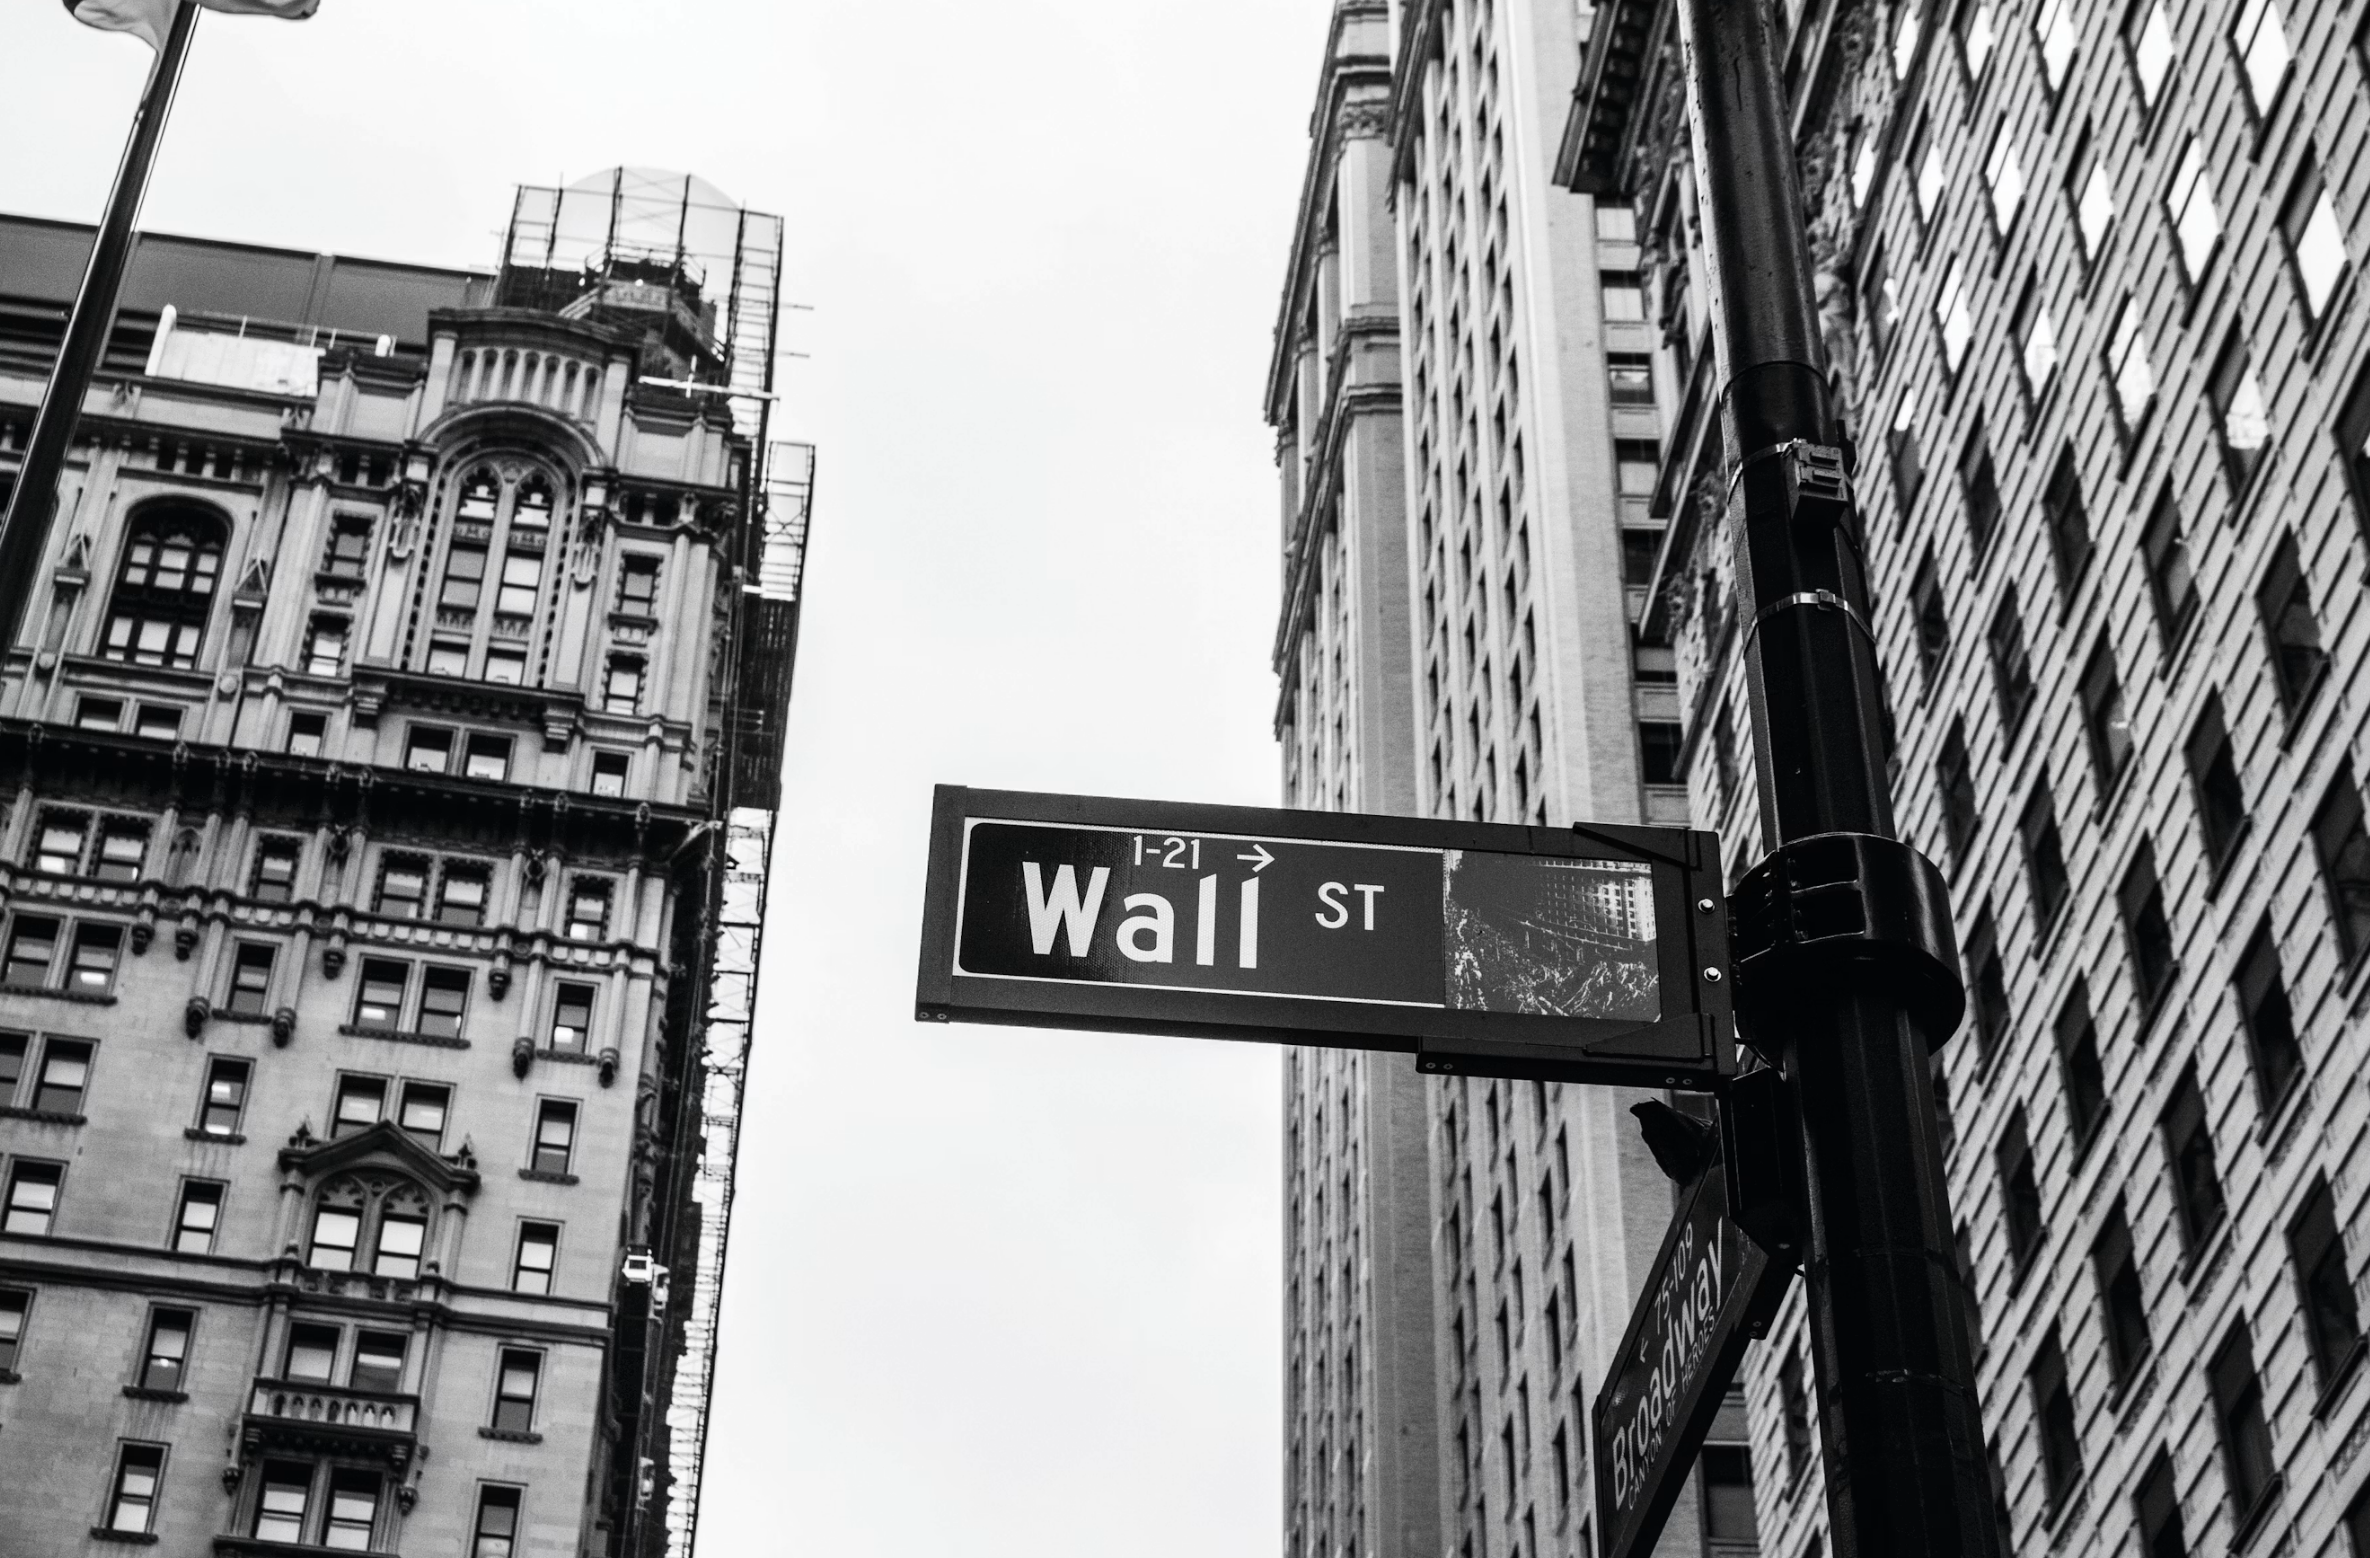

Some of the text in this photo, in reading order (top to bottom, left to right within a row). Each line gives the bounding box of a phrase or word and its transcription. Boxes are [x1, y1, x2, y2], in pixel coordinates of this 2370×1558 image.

[1133, 835, 1201, 870] 1-21
[1022, 861, 1385, 969] Wall ST
[1654, 1222, 1693, 1335] 75-109
[1612, 1216, 1723, 1511] Broadway
[1628, 1306, 1715, 1511] CANYON OF HEROES
